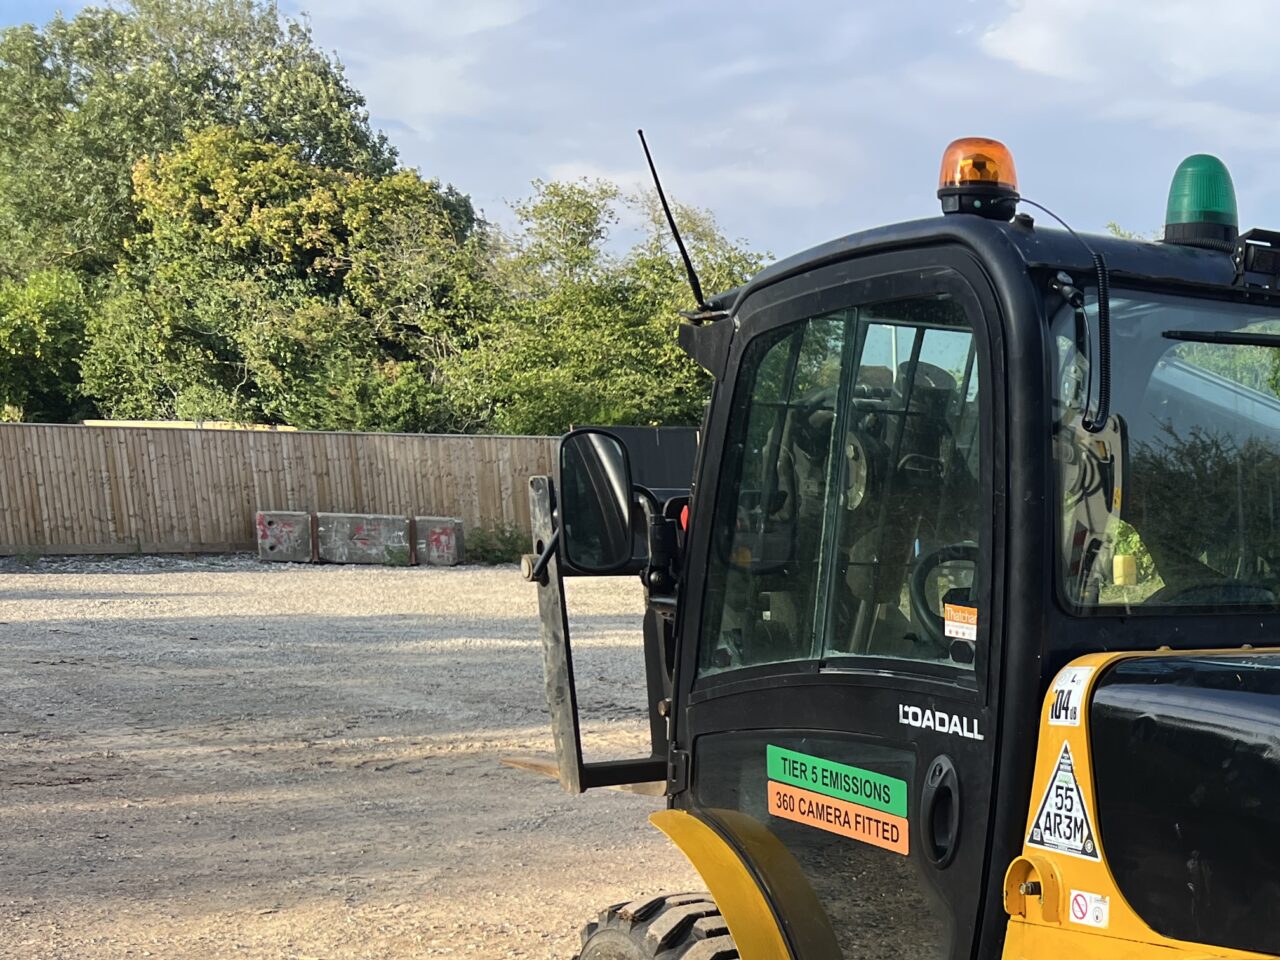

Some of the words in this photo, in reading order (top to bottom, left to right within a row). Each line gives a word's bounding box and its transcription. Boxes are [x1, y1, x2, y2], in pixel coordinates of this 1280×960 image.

[899, 703, 985, 741] LOADALL
[781, 757, 808, 781] TIER
[811, 766, 818, 784] 5
[821, 768, 891, 804] EMISSIONS
[1055, 785, 1074, 813] 55
[776, 791, 795, 812] 360
[798, 797, 852, 830] CAMERA
[854, 813, 900, 843] FITTED
[1043, 811, 1084, 844] AR3M
